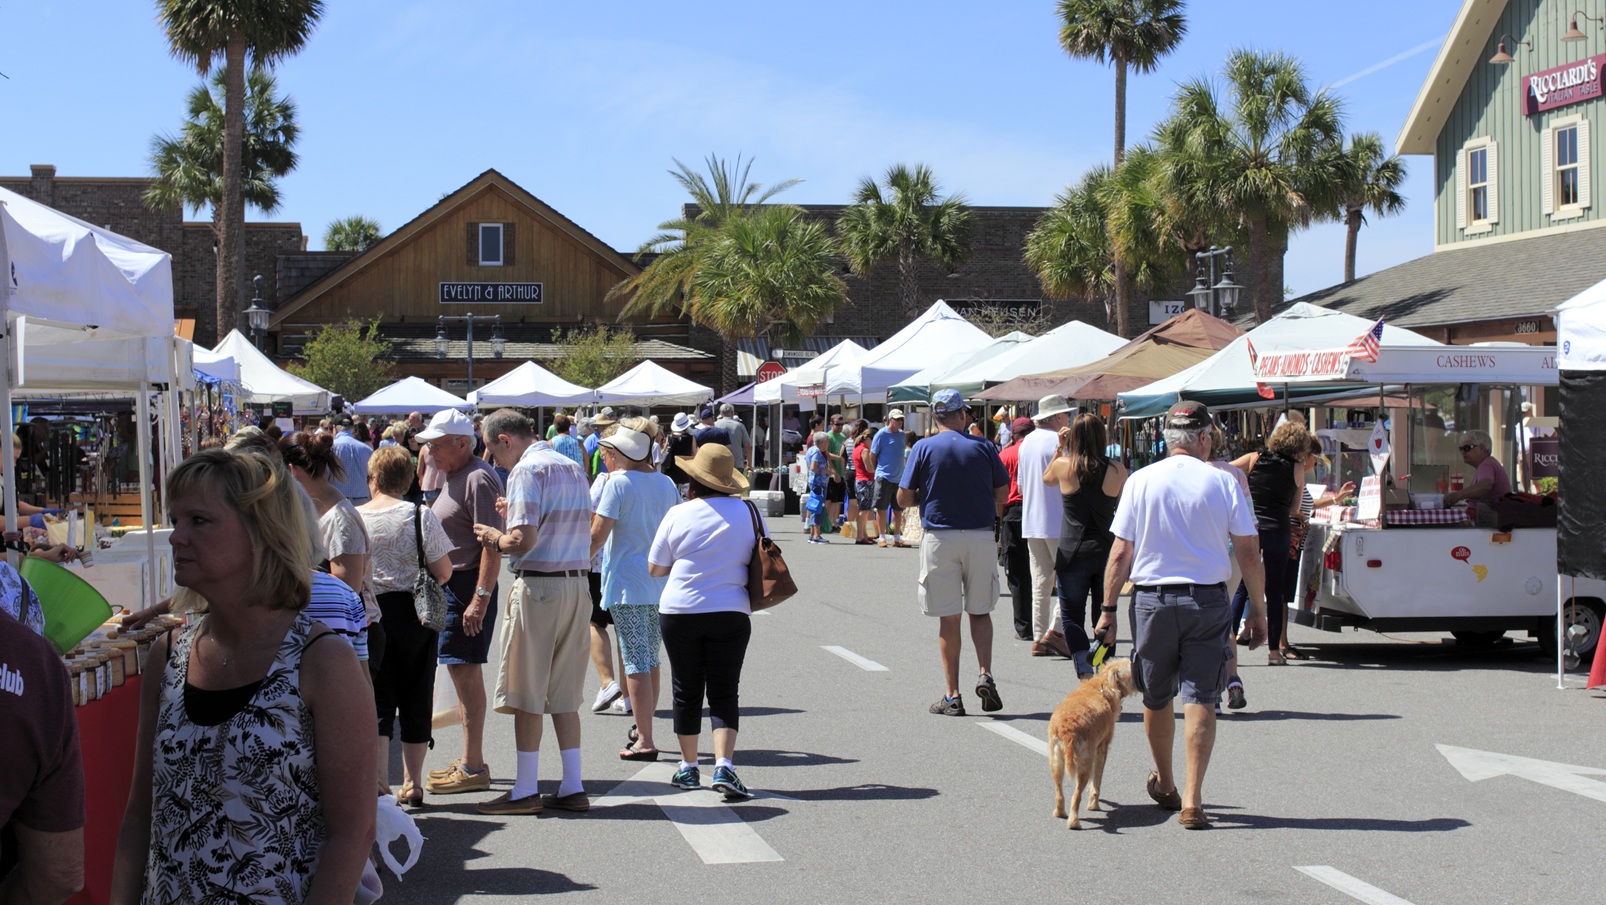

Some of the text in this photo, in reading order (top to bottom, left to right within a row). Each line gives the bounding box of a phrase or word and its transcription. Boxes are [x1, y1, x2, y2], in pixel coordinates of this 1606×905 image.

[1530, 59, 1597, 103] RICCIARDI'S
[1548, 82, 1598, 104] ITALIAN TABLE
[444, 285, 539, 300] EVELYN & ARTHUR
[1517, 321, 1536, 333] 3660
[1311, 351, 1344, 375] CASHEWS
[1436, 355, 1496, 368] CASHEWS
